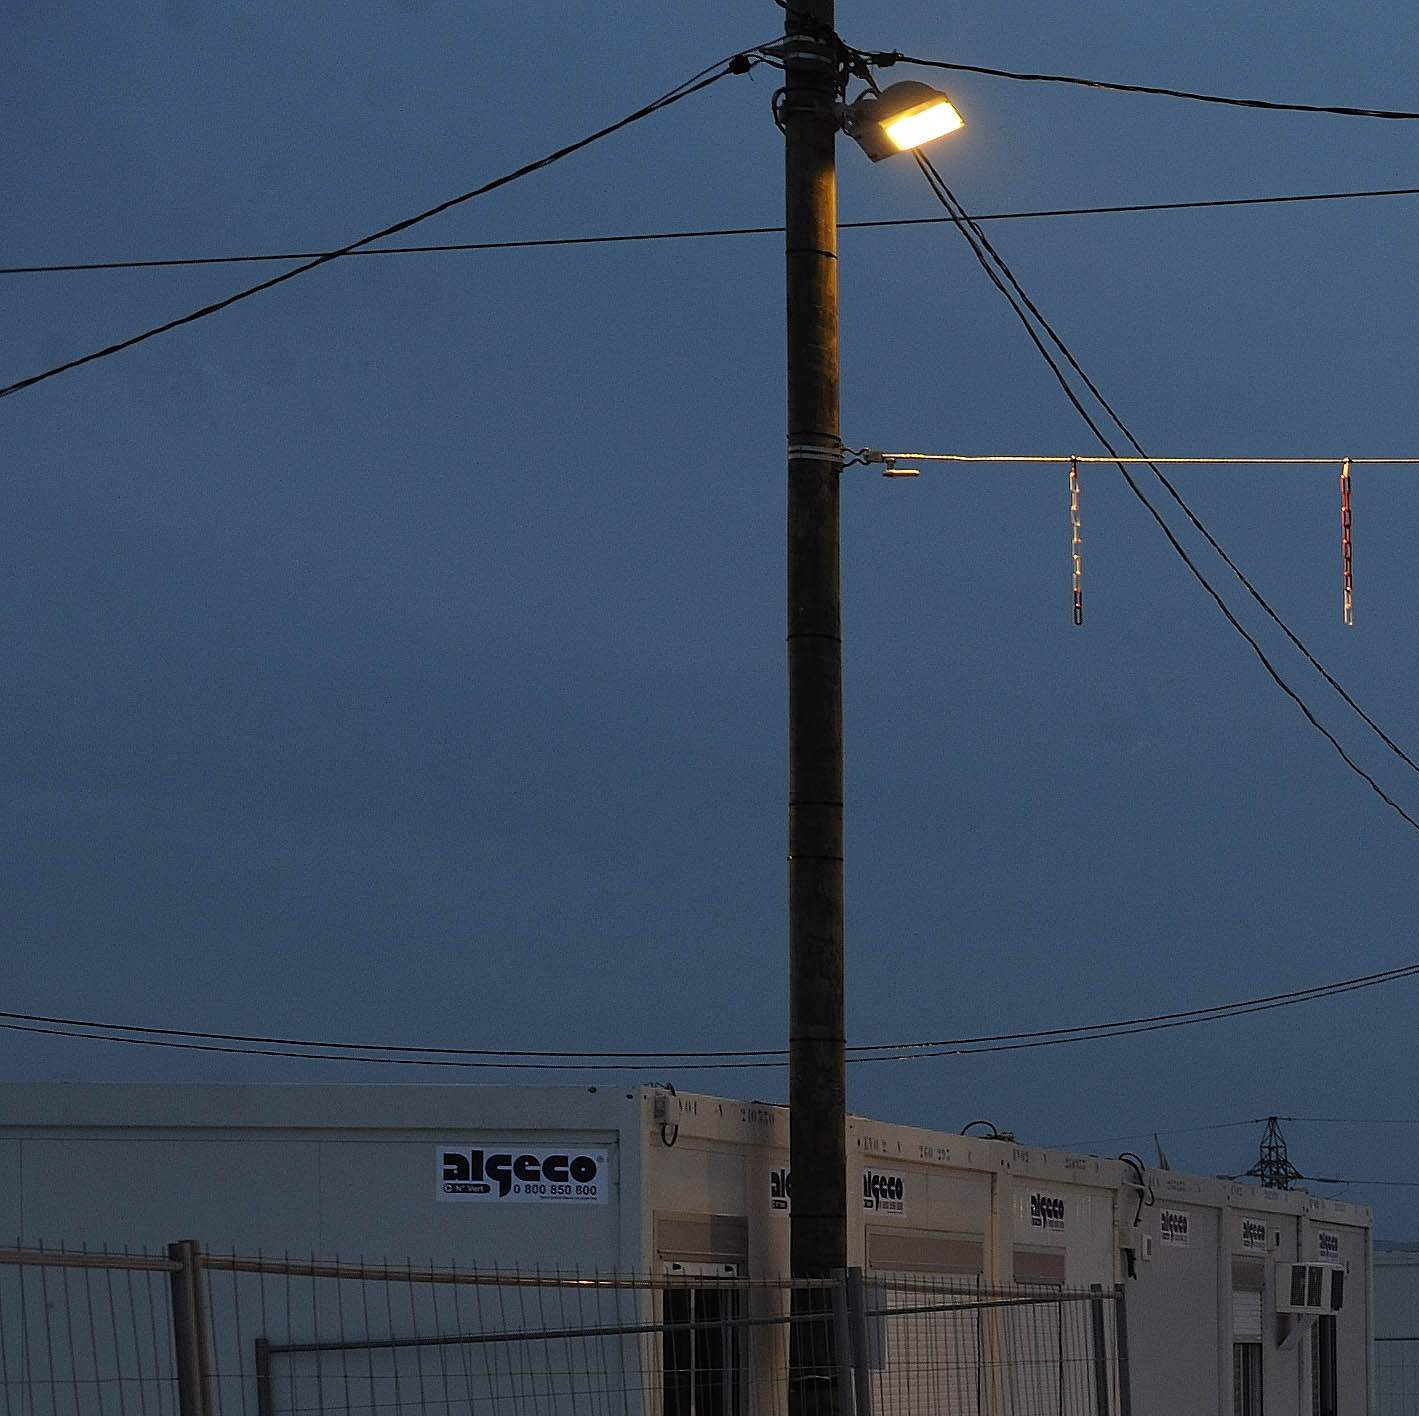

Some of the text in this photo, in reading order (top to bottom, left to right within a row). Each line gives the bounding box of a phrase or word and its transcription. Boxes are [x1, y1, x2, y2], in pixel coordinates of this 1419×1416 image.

[443, 1150, 597, 1198] algeco
[467, 1184, 484, 1193] Vert
[513, 1184, 597, 1196] 0 800 850 800
[1031, 1193, 1064, 1229] algeco
[1161, 1211, 1188, 1243] algeco
